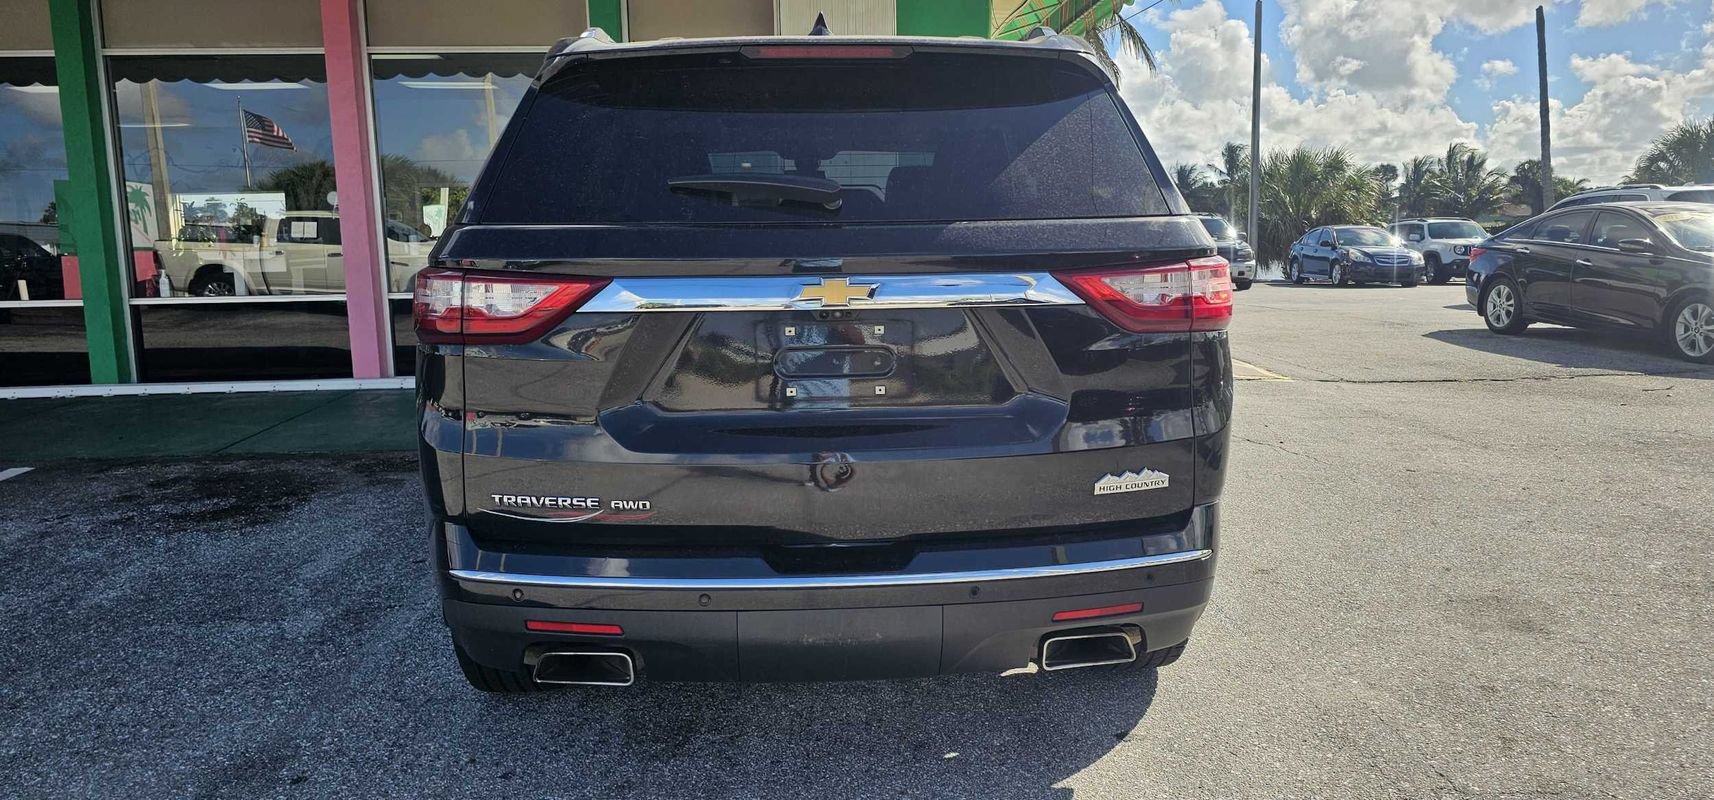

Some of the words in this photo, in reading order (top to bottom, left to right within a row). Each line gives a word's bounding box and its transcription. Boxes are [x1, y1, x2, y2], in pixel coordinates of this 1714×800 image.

[1099, 485, 1122, 493] HIGH
[1125, 479, 1166, 490] COUNTRY
[491, 494, 600, 509] TRAVERSE
[610, 500, 652, 510] AWD
